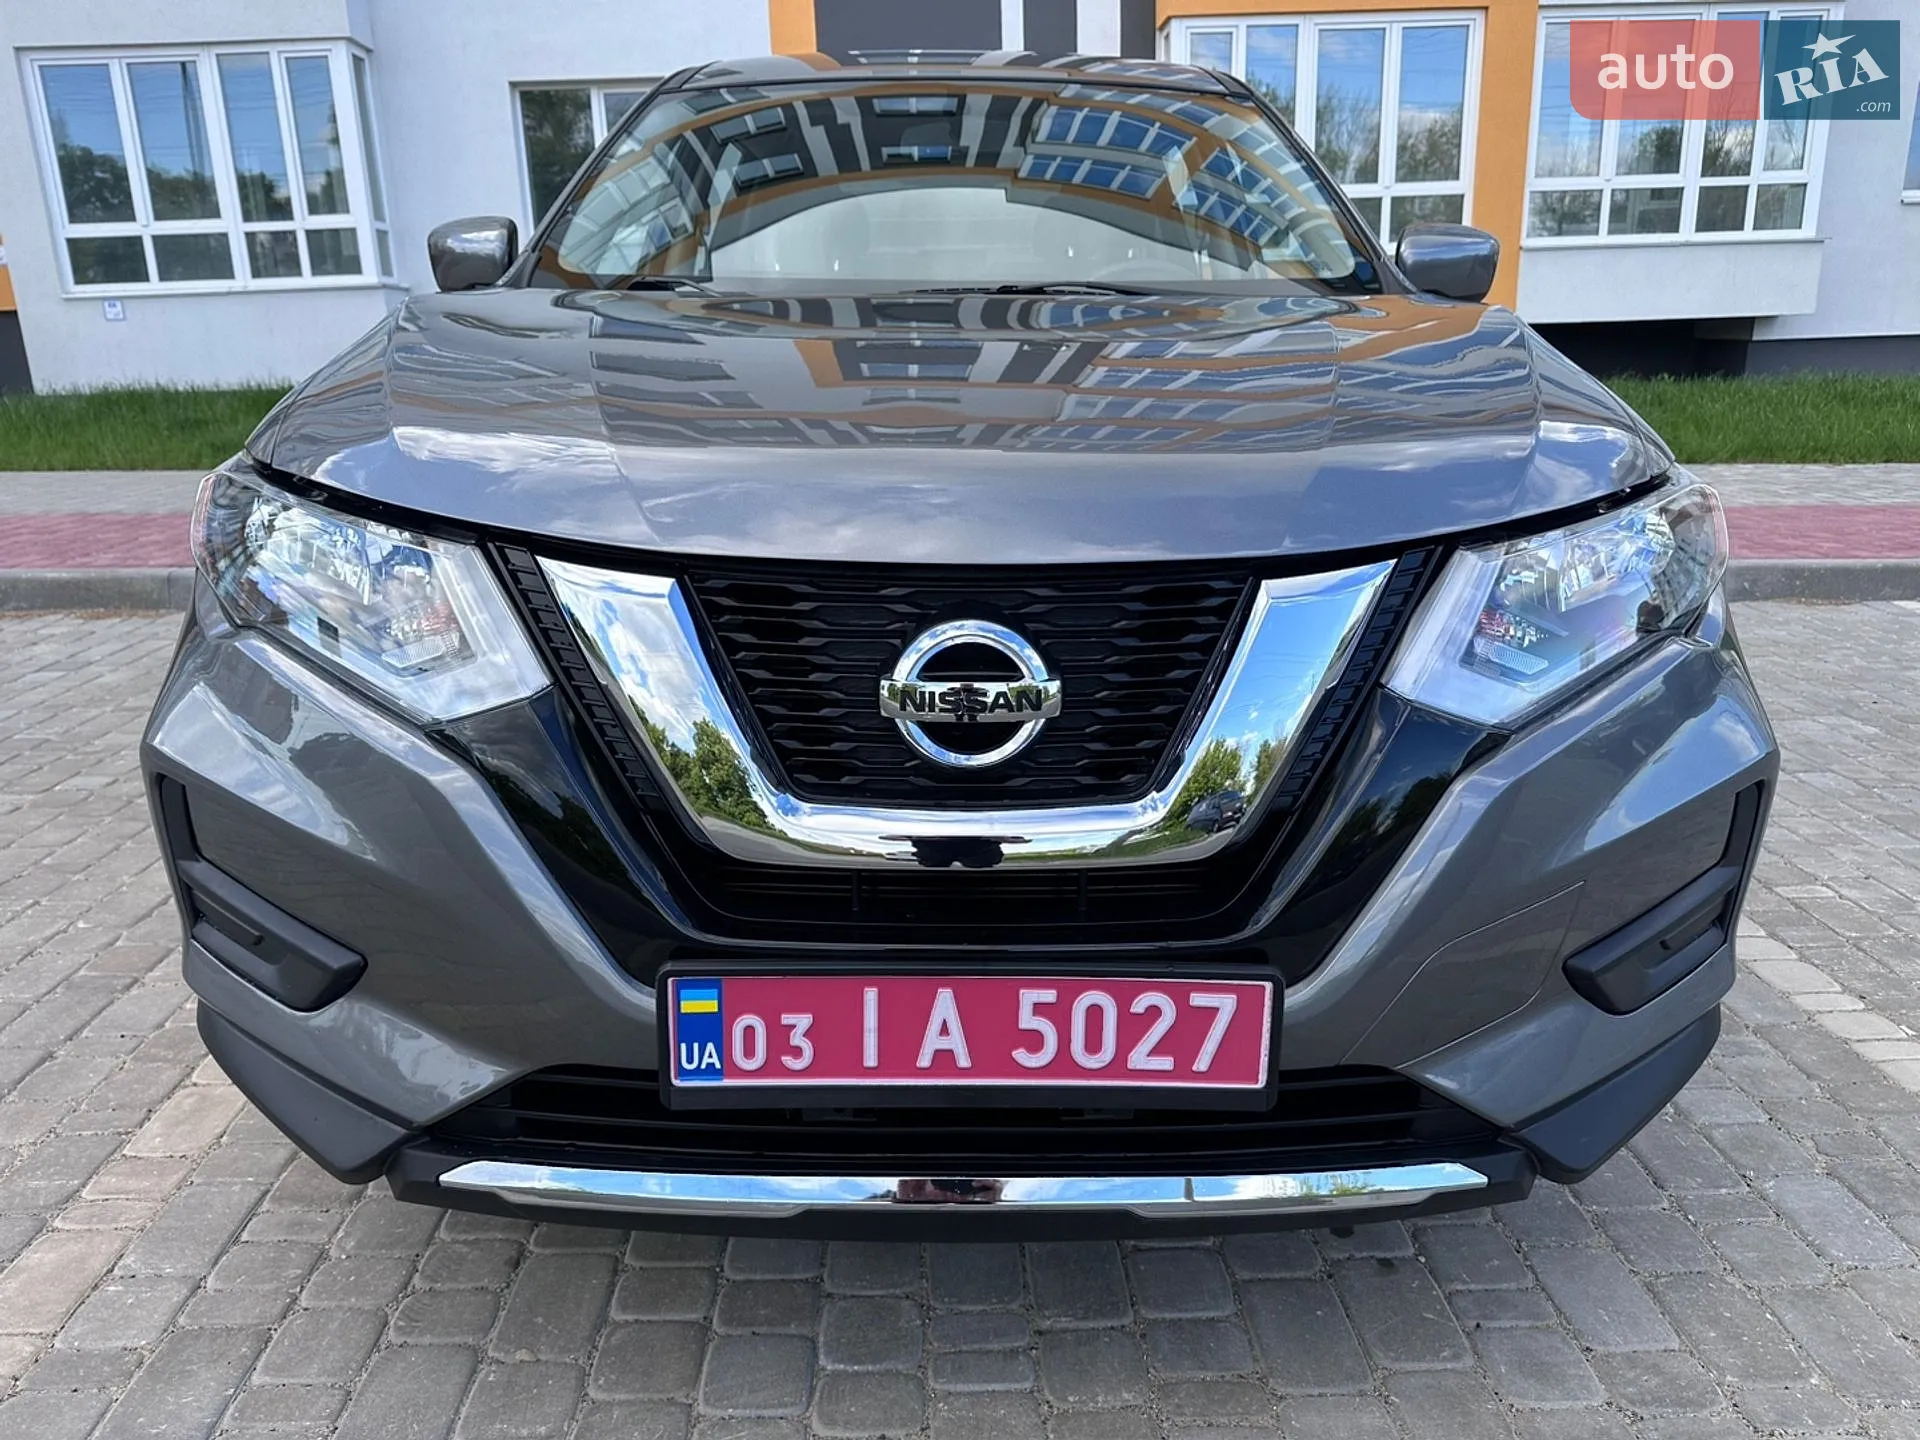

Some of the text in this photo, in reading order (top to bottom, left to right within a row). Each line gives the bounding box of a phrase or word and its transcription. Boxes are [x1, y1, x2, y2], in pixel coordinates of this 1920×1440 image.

[899, 689, 1043, 713] NISSAN
[731, 1014, 814, 1071] 03
[1011, 989, 1238, 1072] 5027
[680, 1043, 721, 1069] UA
